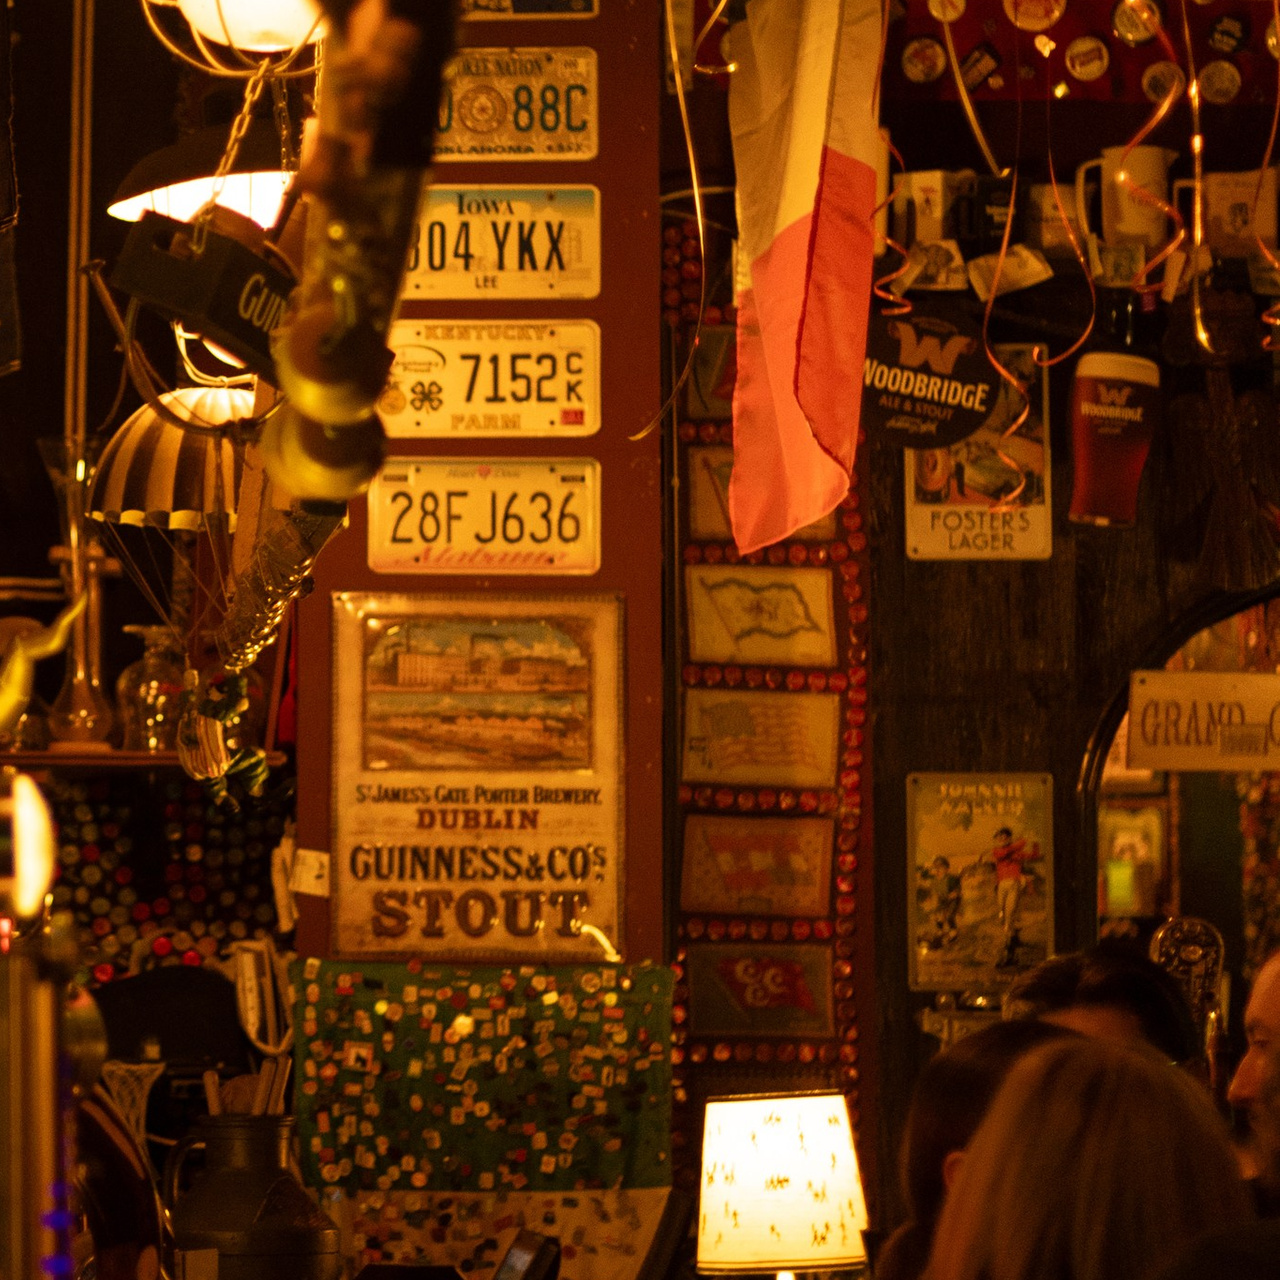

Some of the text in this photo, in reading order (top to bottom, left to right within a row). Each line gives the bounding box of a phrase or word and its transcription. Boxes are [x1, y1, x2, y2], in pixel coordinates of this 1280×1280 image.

[513, 84, 588, 132] 88C
[491, 221, 566, 272] YKX
[475, 274, 499, 290] LEE
[424, 323, 547, 341] KENTUCKY
[460, 352, 558, 404] 7152
[863, 356, 991, 414] WOODBRIDGE
[451, 414, 521, 430] FARM
[390, 491, 581, 544] 28F J636
[948, 532, 1015, 551] LAGER
[416, 808, 540, 830] DUBLIN
[371, 888, 592, 939] STOUT
